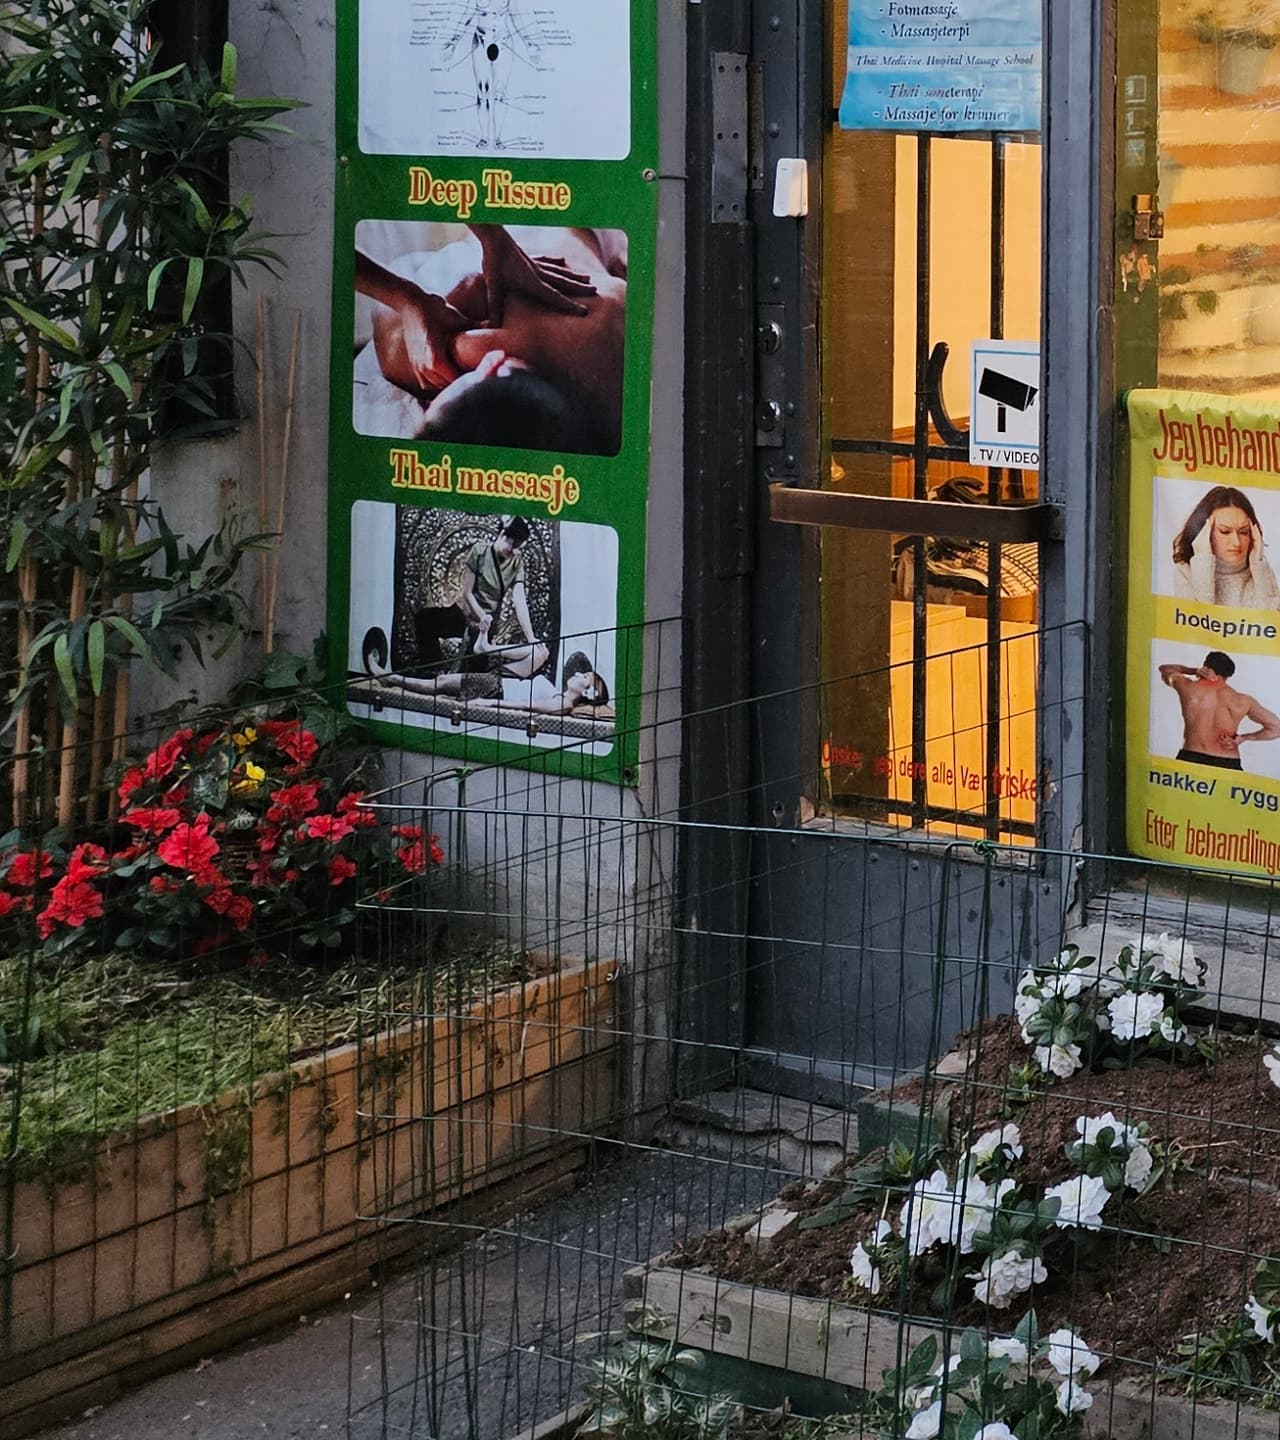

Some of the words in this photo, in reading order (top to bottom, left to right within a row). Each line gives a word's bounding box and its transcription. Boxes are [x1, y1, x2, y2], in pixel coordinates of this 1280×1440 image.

[889, 84, 920, 98] Thai
[409, 167, 476, 218] Deep
[483, 168, 571, 211] Tissue
[979, 449, 993, 461] TV
[1003, 450, 1039, 464] VIDEO
[1153, 409, 1197, 473] Jeg
[390, 449, 451, 494] Thai
[456, 463, 580, 516] massasje
[1175, 608, 1278, 639] hodepine
[932, 761, 953, 785] alle
[1148, 768, 1217, 797] nakke/
[1230, 785, 1279, 812] rygg
[1145, 809, 1179, 851] Etter
